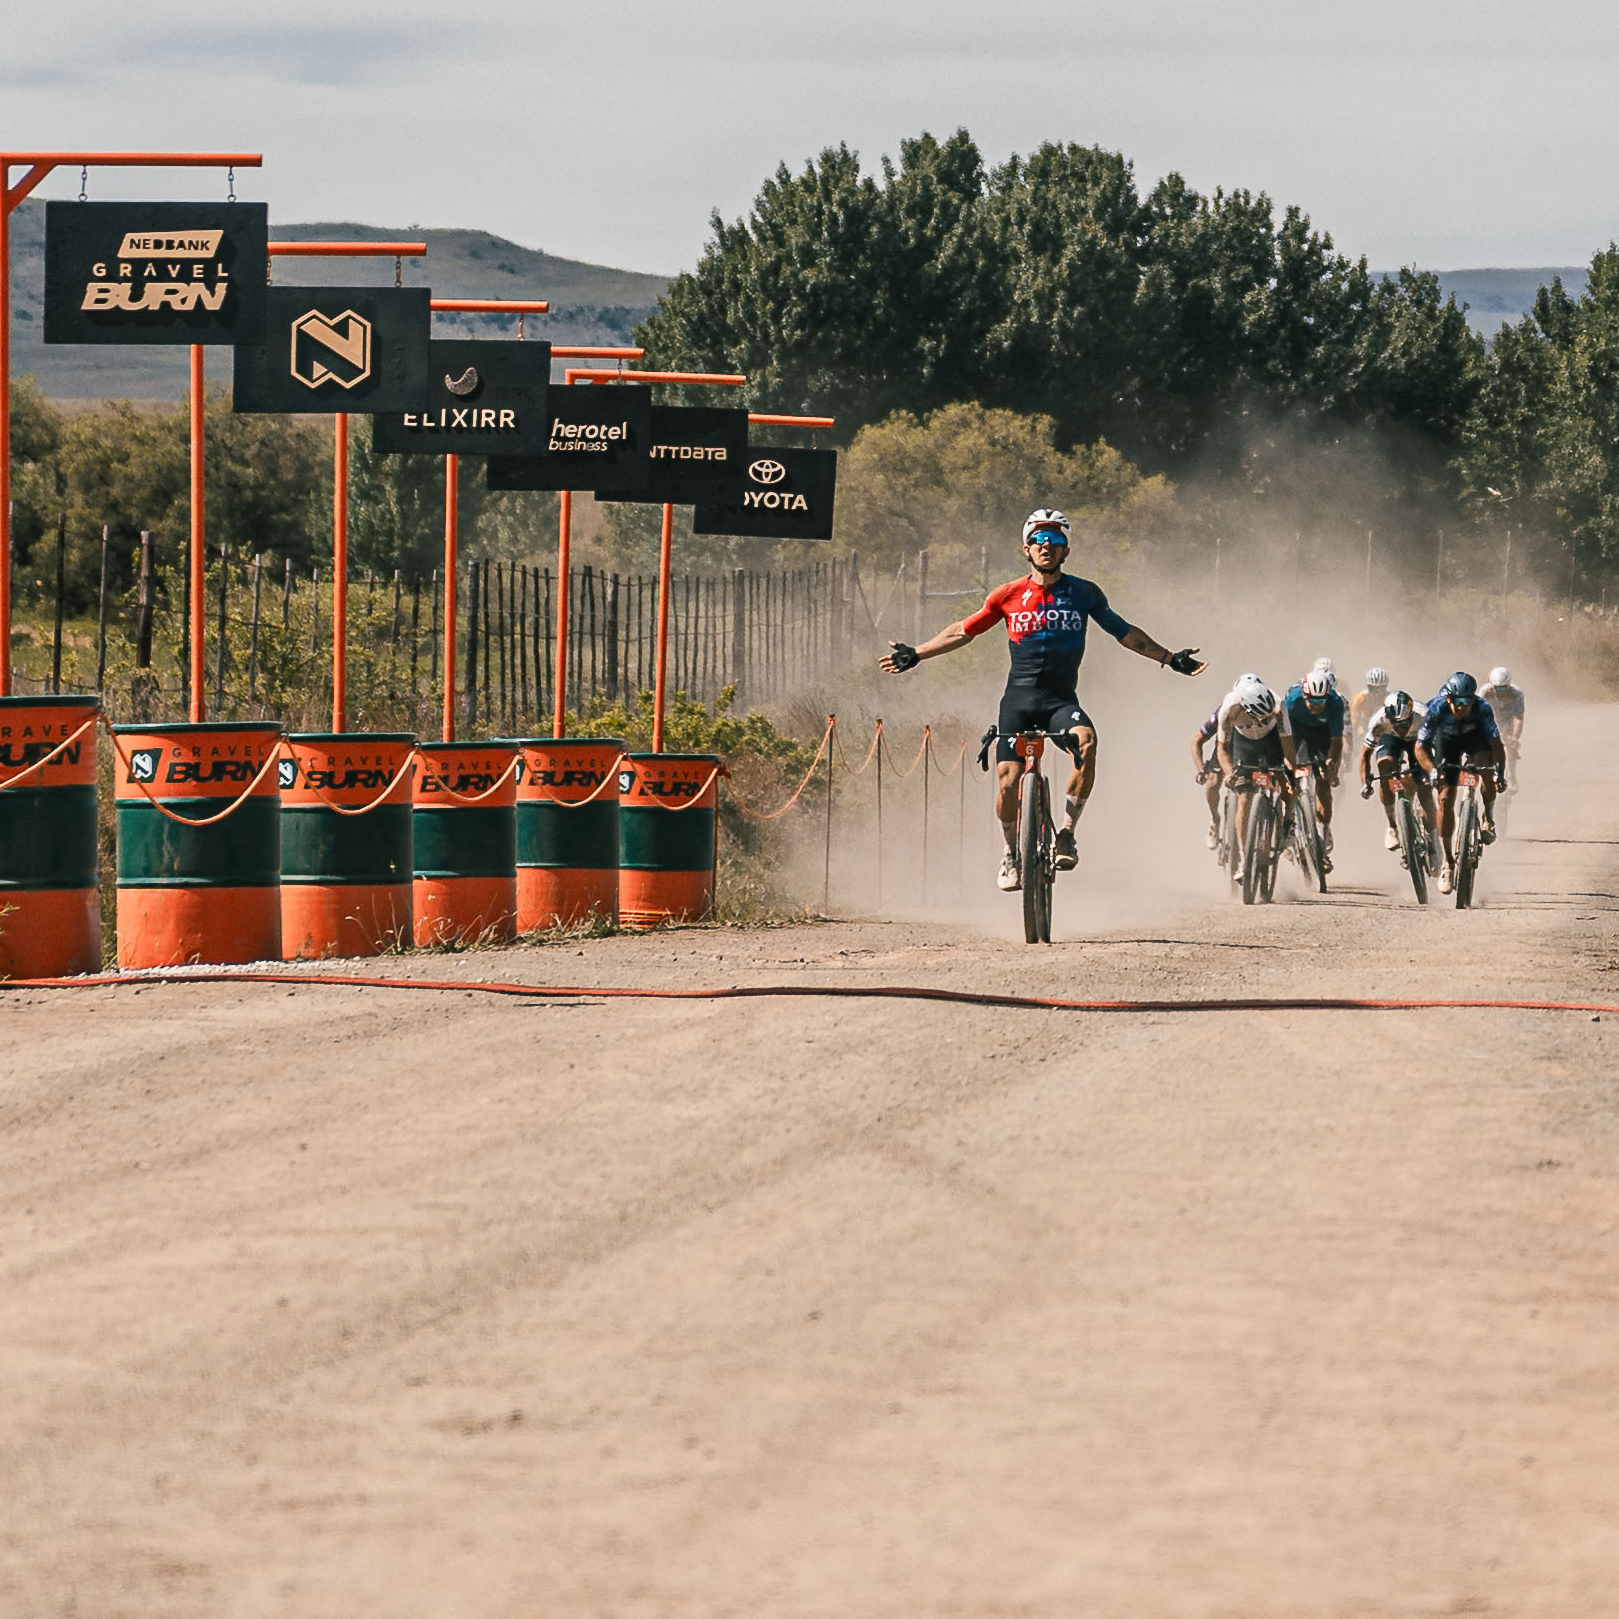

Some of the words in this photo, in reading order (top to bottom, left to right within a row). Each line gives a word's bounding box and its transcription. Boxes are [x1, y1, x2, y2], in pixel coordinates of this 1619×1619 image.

[129, 238, 210, 251] NEDBANK
[92, 262, 229, 278] GRAVEL
[81, 282, 229, 311] BURN
[403, 408, 515, 428] ELIXIRR
[551, 417, 627, 440] herotel
[548, 438, 608, 452] business
[743, 491, 808, 511] YOTA
[1009, 609, 1081, 623] TOYOTA
[172, 745, 264, 758] GRAVEL
[166, 760, 265, 783] BURN
[304, 769, 395, 789] BURN
